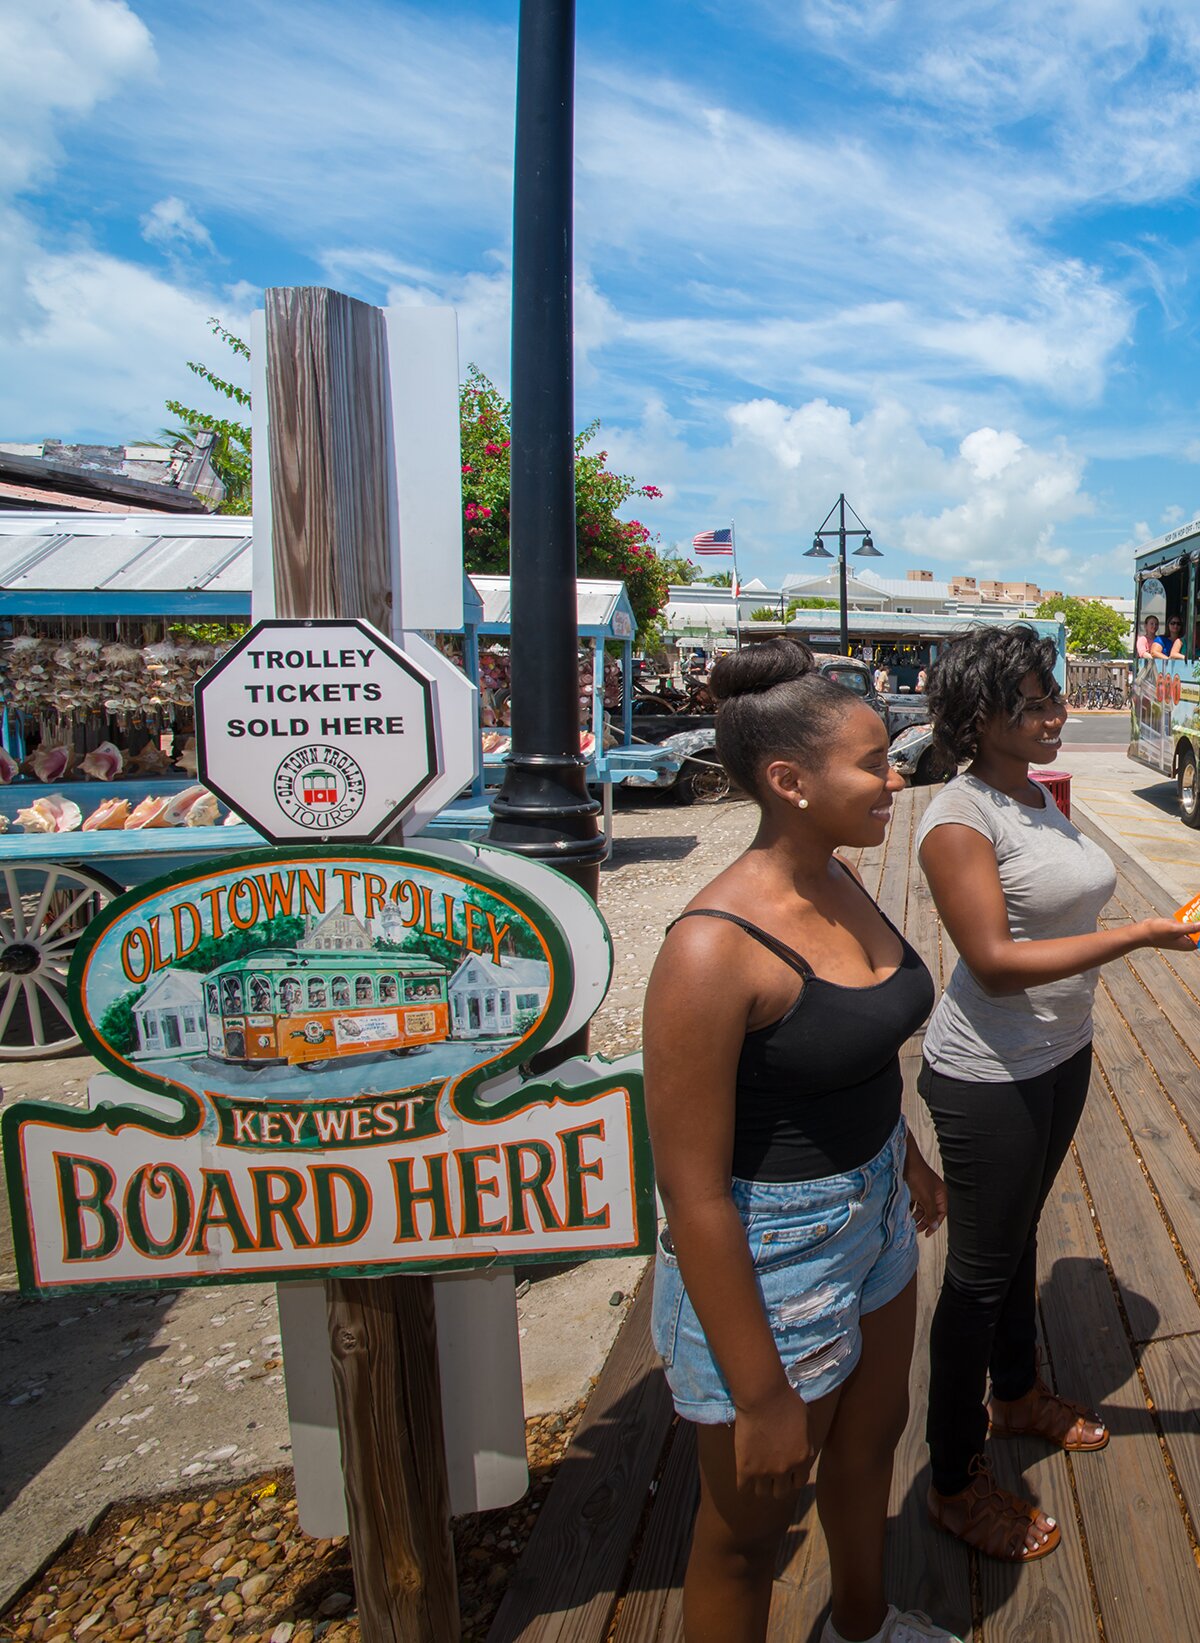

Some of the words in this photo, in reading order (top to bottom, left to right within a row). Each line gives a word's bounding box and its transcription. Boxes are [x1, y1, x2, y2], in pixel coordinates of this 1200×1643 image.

[247, 650, 375, 669] TROLLEY
[245, 683, 382, 703] TICKETS
[227, 719, 309, 737] SOLD
[321, 717, 404, 736] HERE
[283, 747, 318, 773] TOWN
[323, 747, 363, 796] TROLLEY
[277, 774, 293, 797] OLD
[292, 803, 356, 827] TOURS
[122, 900, 201, 984] OLD
[201, 868, 326, 940] TOWN
[332, 868, 511, 966] TROLLEY
[233, 1108, 308, 1144] KEY
[314, 1099, 424, 1143] WEST
[53, 1150, 372, 1264] BOARD
[388, 1118, 612, 1244] HERE
